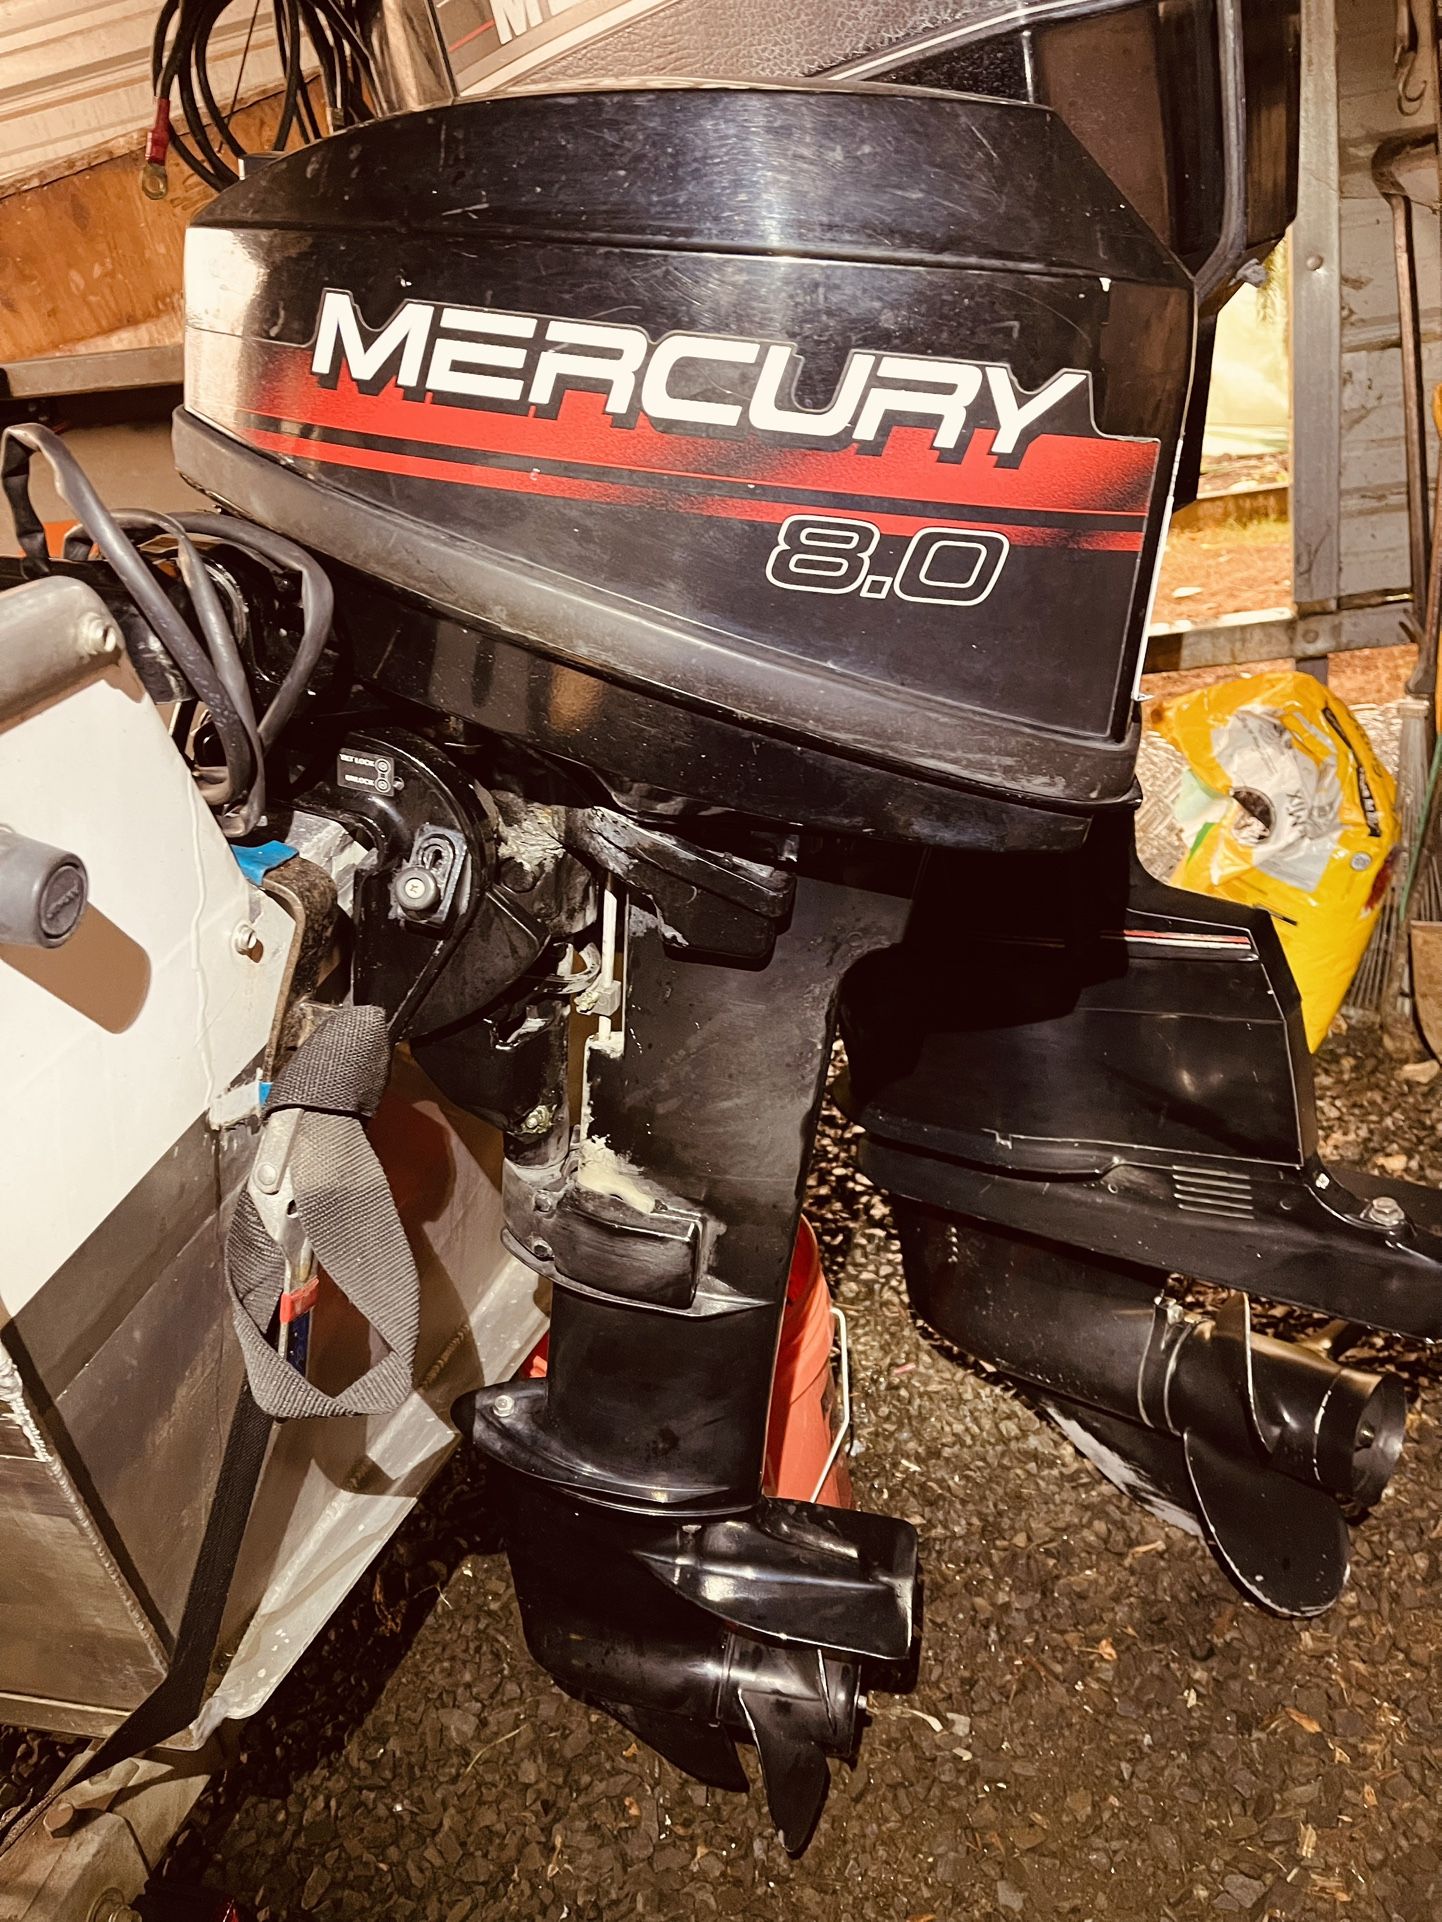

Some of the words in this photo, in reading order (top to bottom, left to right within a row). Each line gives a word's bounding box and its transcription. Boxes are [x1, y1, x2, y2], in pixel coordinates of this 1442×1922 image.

[311, 289, 1089, 455] MERCURY
[765, 514, 1010, 606] 8.0
[354, 757, 375, 767] LOCK
